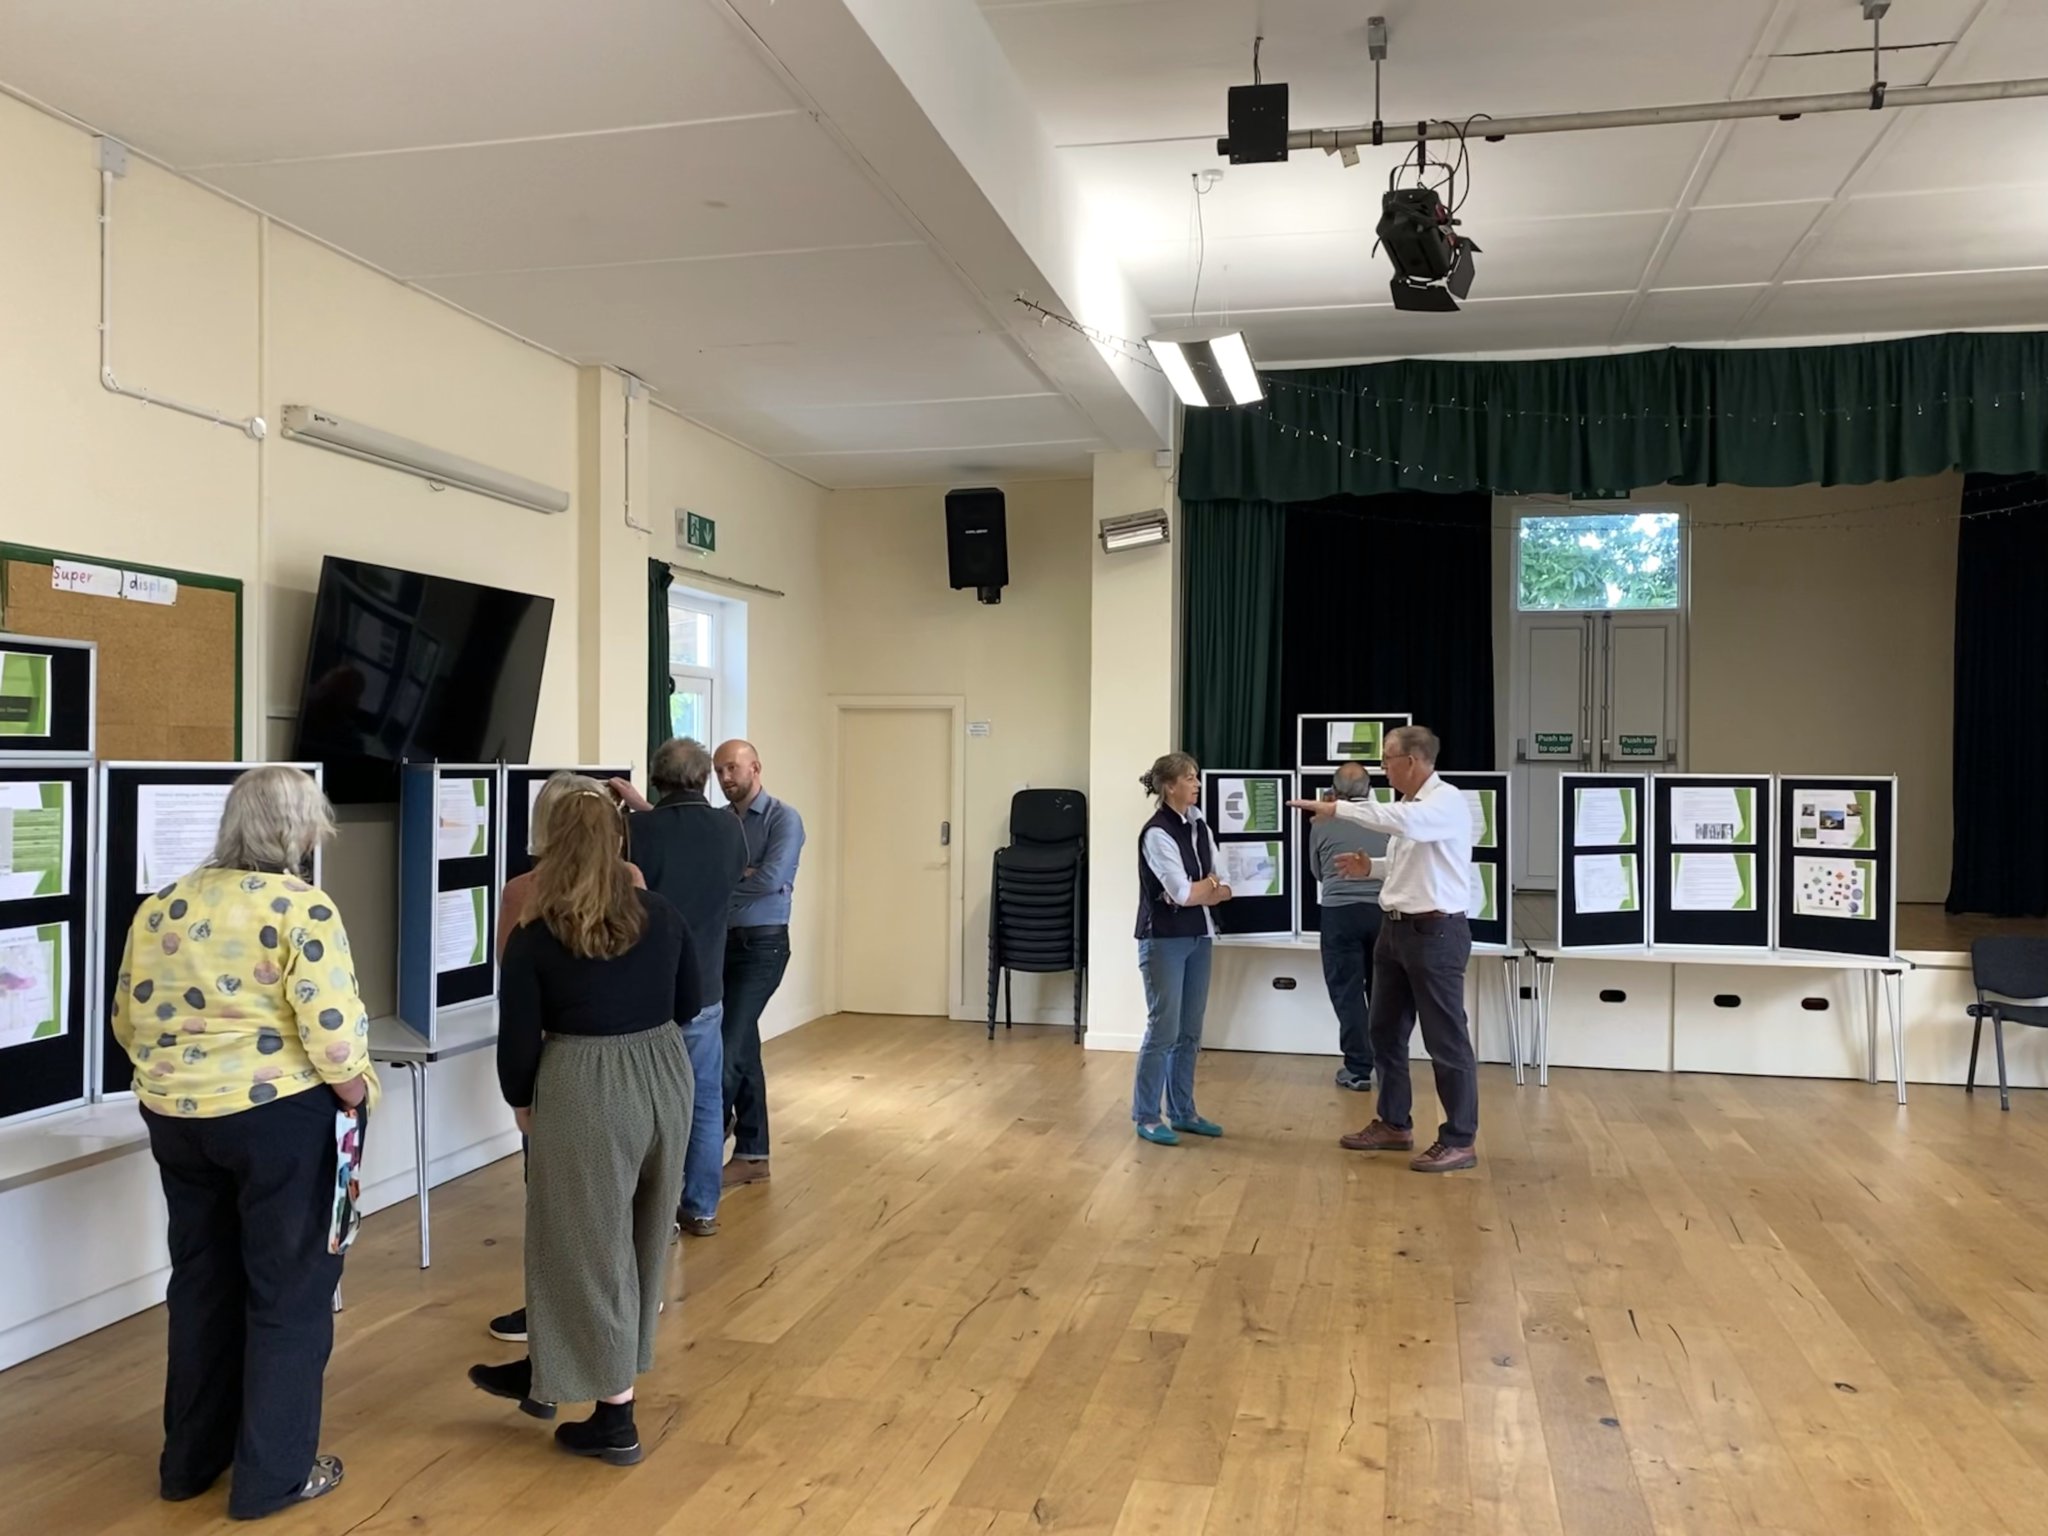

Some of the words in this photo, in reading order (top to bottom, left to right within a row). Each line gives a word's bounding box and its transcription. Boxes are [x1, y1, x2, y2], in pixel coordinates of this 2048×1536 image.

[53, 566, 93, 589] Super
[1537, 734, 1558, 742] Push
[1559, 734, 1573, 742] bar
[1621, 736, 1642, 744] Push
[1643, 736, 1656, 744] bar
[1548, 745, 1569, 754] open
[1632, 747, 1653, 756] open
